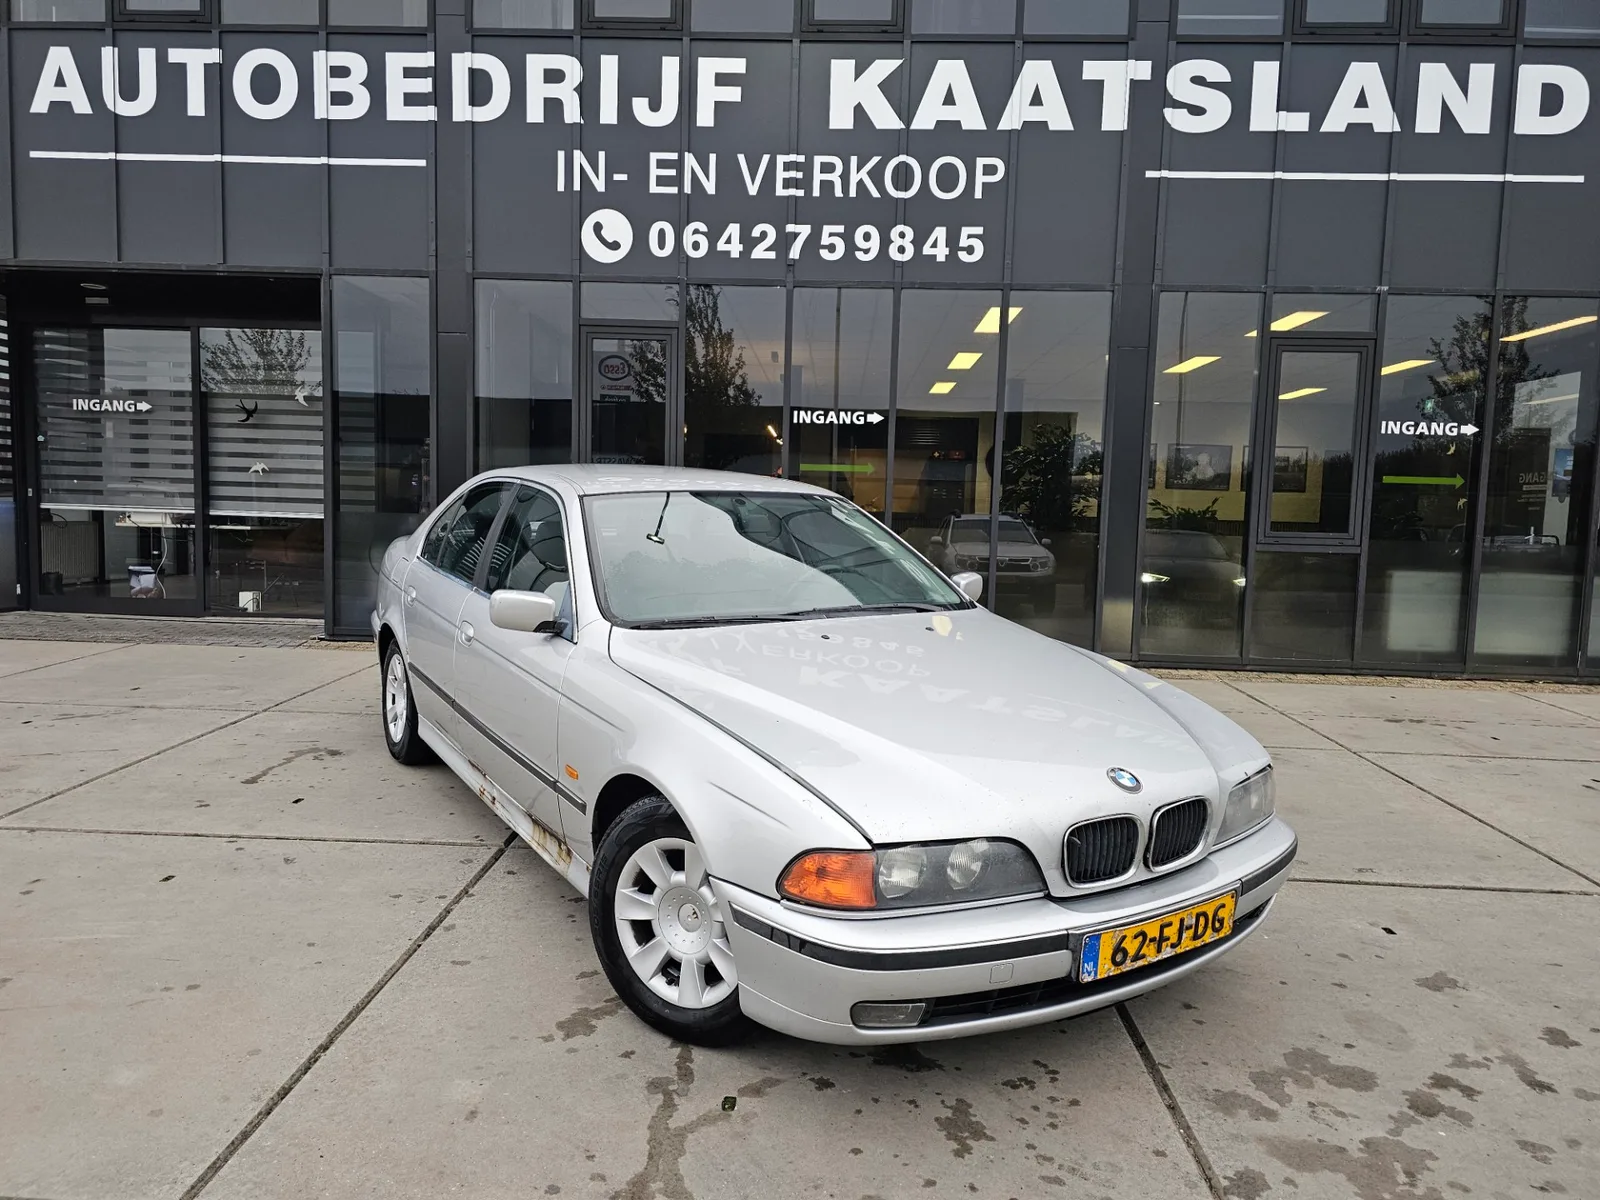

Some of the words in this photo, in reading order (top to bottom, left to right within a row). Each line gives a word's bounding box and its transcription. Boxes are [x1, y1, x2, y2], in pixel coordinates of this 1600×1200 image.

[30, 46, 747, 127] AUTOBEDRIJF
[828, 58, 1590, 135] KAATSLAND
[557, 150, 628, 192] IN-
[649, 151, 717, 195] EN
[737, 153, 1006, 200] VERKOOP
[648, 220, 985, 262] 0642759845
[72, 398, 135, 412] INGANG
[793, 410, 865, 425] INGANG
[1381, 420, 1458, 436] INGANG
[1110, 902, 1228, 968] 62-FJ-DG
